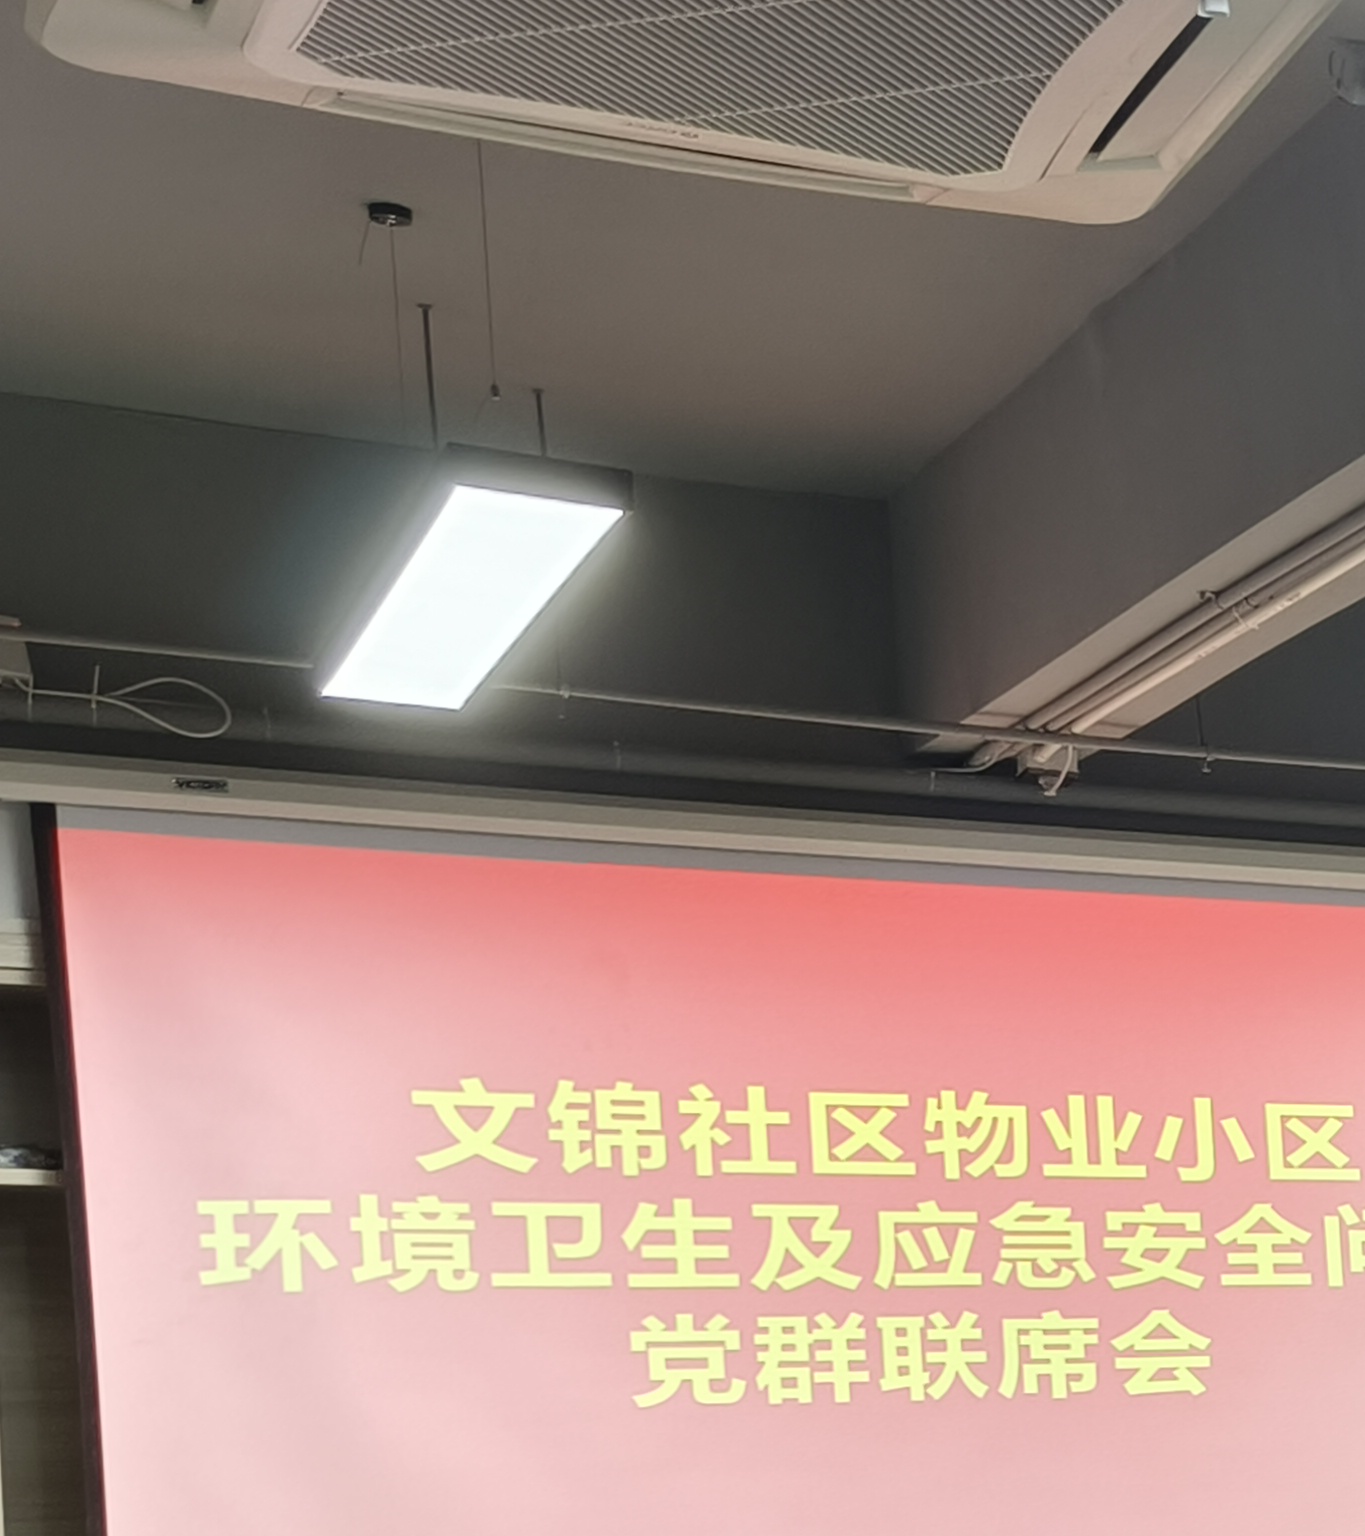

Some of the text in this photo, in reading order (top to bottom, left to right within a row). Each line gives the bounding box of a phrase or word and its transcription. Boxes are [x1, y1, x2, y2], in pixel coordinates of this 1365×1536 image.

[409, 1077, 1363, 1186] 文锦社区物业小区
[629, 1310, 1213, 1408] 党群联席会
